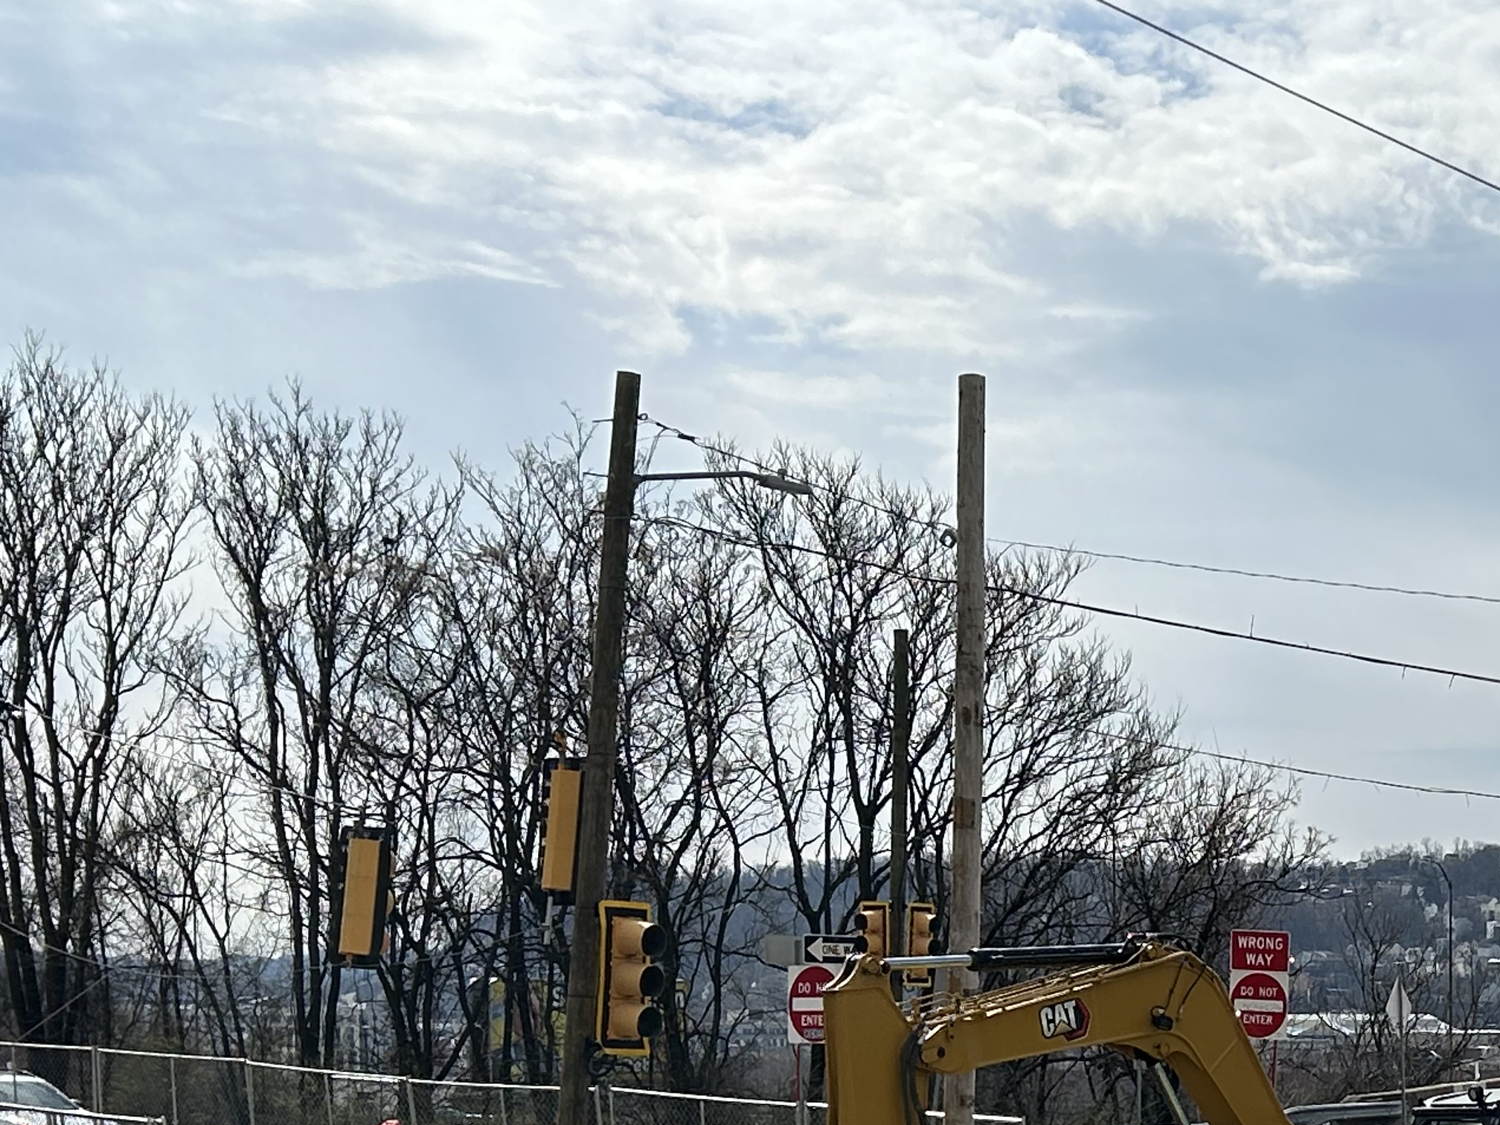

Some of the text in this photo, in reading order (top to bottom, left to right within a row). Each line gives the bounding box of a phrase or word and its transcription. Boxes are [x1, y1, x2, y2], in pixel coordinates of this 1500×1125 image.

[1238, 936, 1283, 950] WRONG
[1246, 953, 1274, 966] WAY
[798, 982, 811, 994] DO
[1240, 986, 1279, 997] DO NOT
[801, 1014, 824, 1027] ENTE
[1040, 1000, 1077, 1037] CAT
[1243, 1014, 1273, 1025] ENTER
